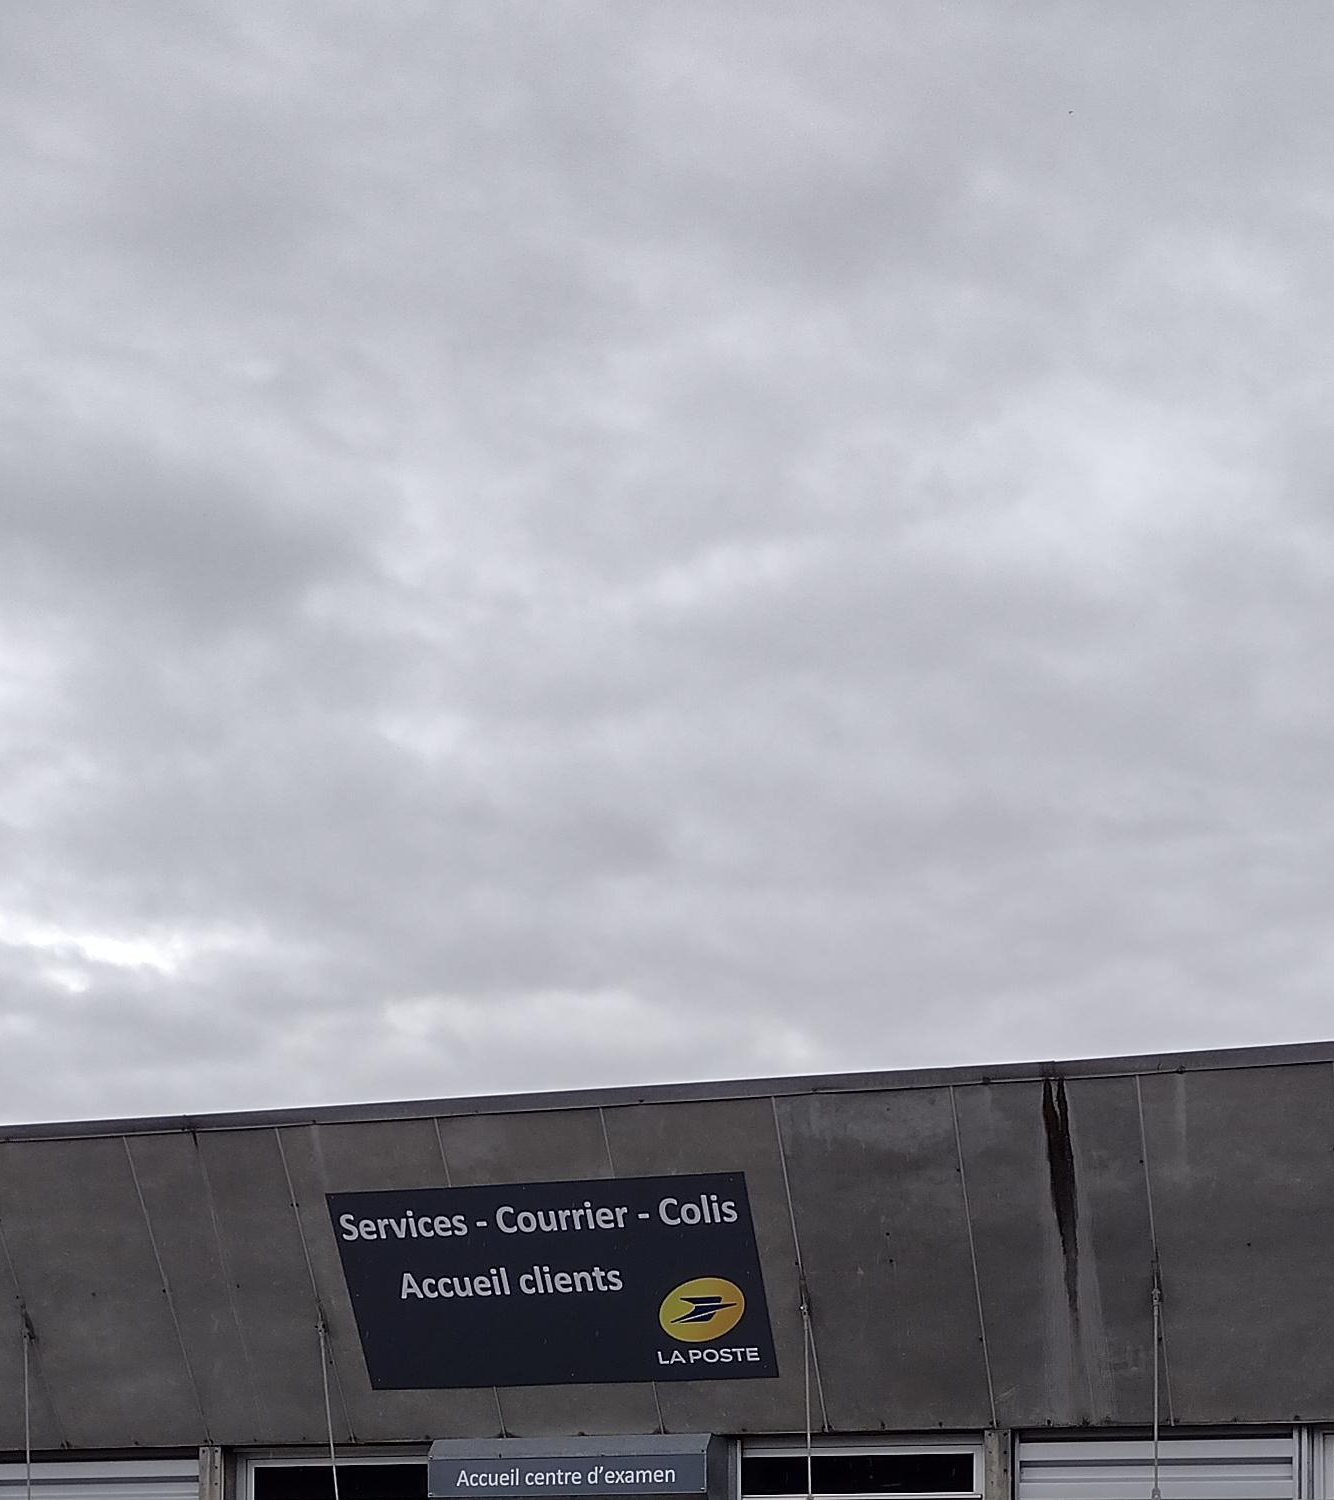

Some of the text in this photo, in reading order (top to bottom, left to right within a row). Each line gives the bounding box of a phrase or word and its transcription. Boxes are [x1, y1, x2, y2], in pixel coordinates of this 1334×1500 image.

[339, 1211, 468, 1241] Services
[495, 1202, 629, 1235] Courrier
[658, 1194, 738, 1227] Colis
[401, 1265, 623, 1300] Accueil clients
[657, 1347, 761, 1365] LA POSTE
[456, 1465, 676, 1488] Accueil centre d'examen
